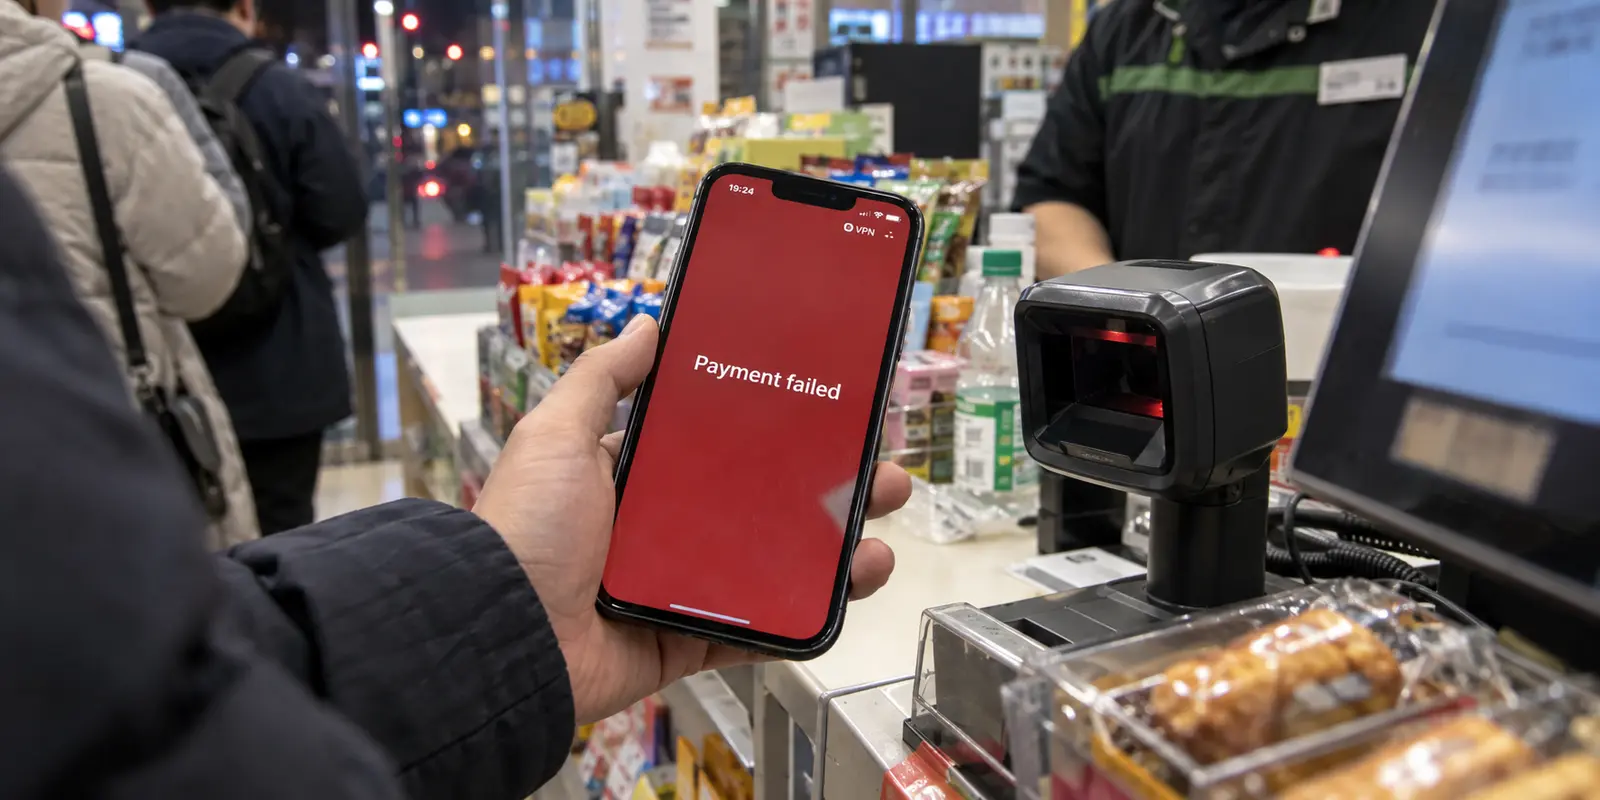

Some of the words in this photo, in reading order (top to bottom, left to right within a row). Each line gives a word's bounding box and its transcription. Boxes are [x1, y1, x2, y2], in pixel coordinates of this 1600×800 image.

[728, 184, 754, 195] 19:24
[855, 226, 875, 236] VPN
[694, 354, 782, 387] Payment
[786, 374, 841, 400] failed
